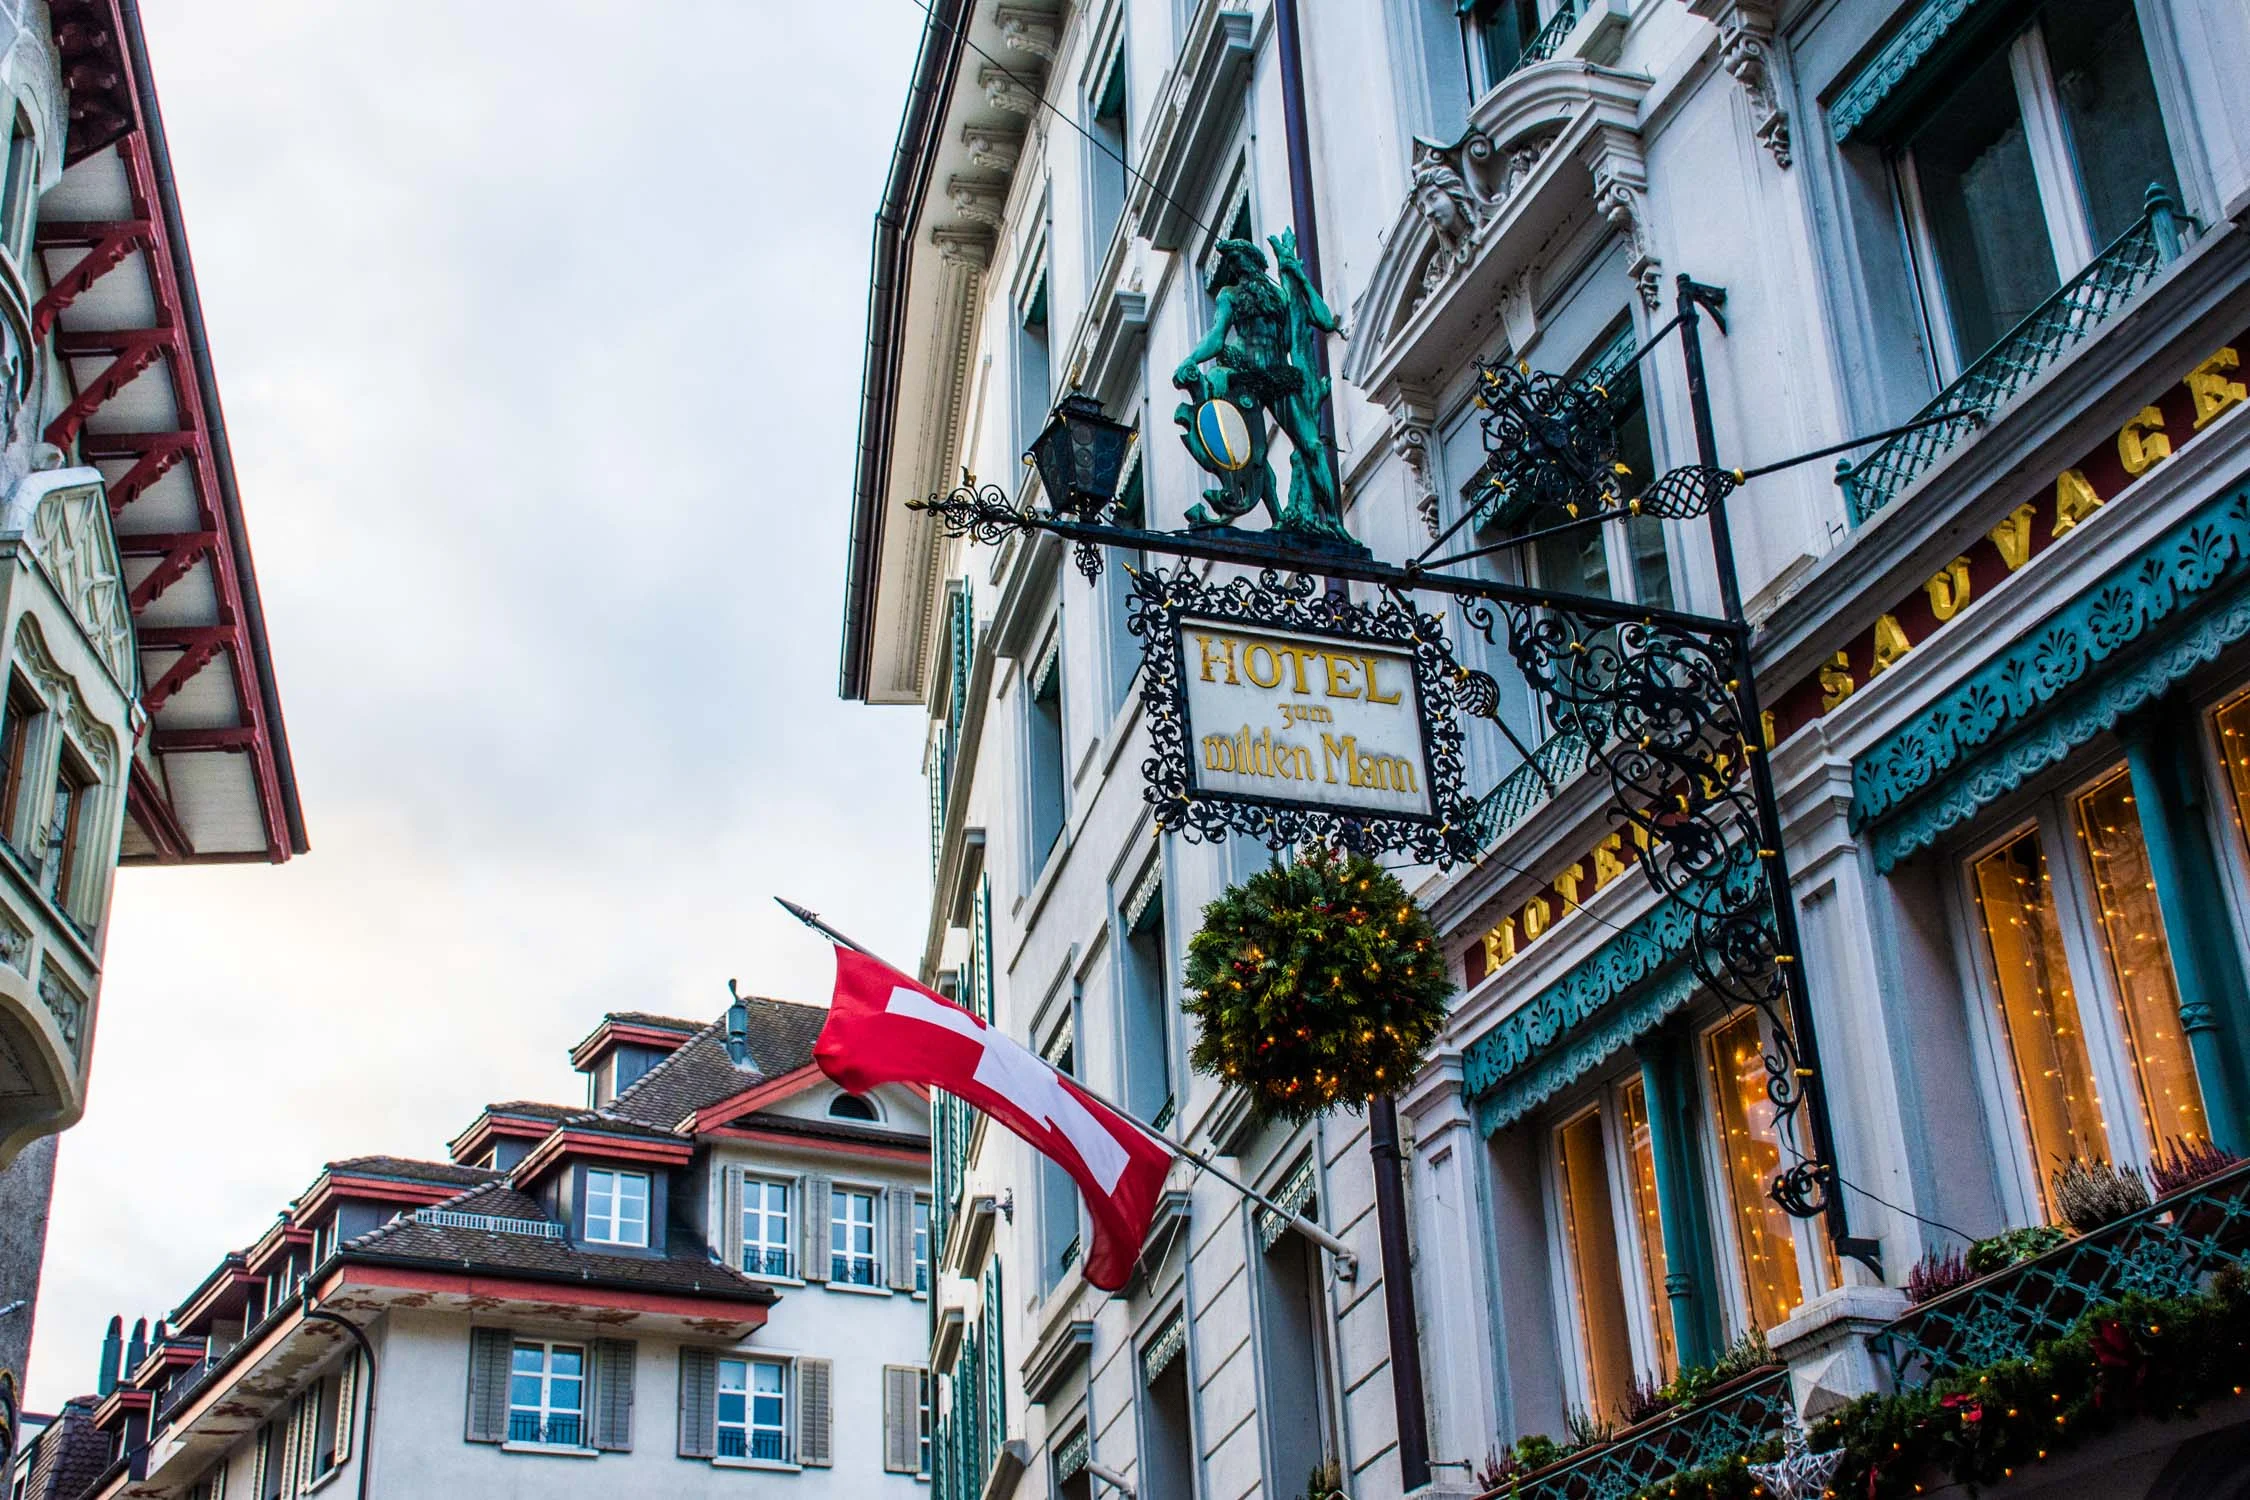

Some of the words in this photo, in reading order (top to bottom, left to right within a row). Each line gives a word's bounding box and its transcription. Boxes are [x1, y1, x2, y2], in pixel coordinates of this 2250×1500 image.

[1818, 346, 2249, 714] SAUVAGE
[1196, 634, 1402, 706] HOTEL
[1277, 703, 1334, 730] zum
[1202, 723, 1316, 782] wilden
[1320, 732, 1419, 793] Mann
